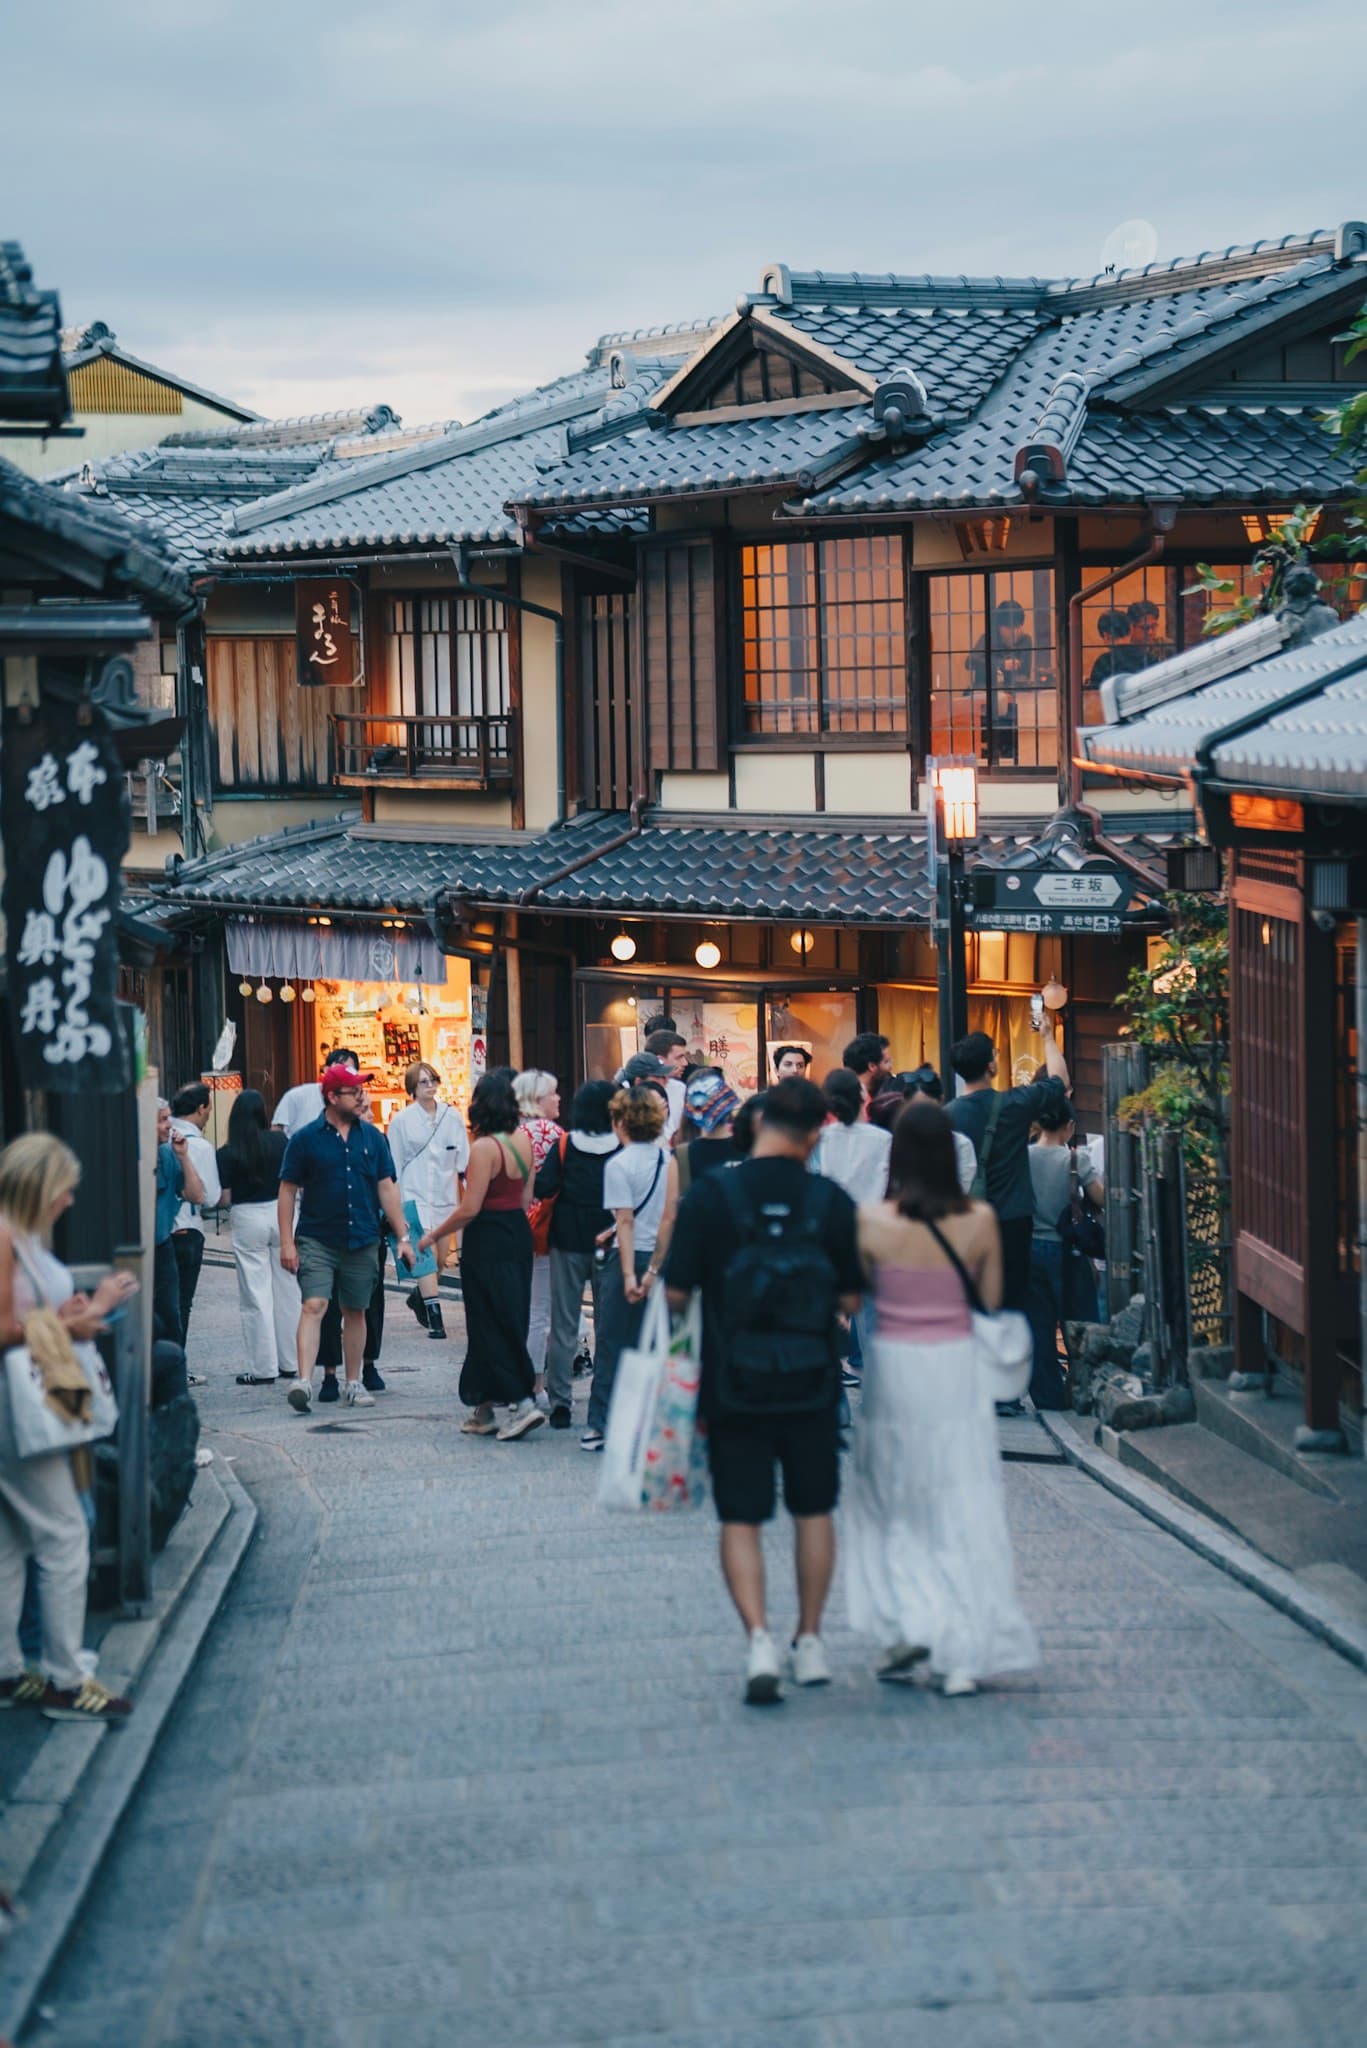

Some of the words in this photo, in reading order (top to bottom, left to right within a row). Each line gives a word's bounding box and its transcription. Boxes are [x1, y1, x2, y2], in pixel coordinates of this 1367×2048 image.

[309, 603, 339, 664] まるん
[1054, 878, 1102, 892] 二年坂
[1064, 915, 1093, 925] 高台寺
